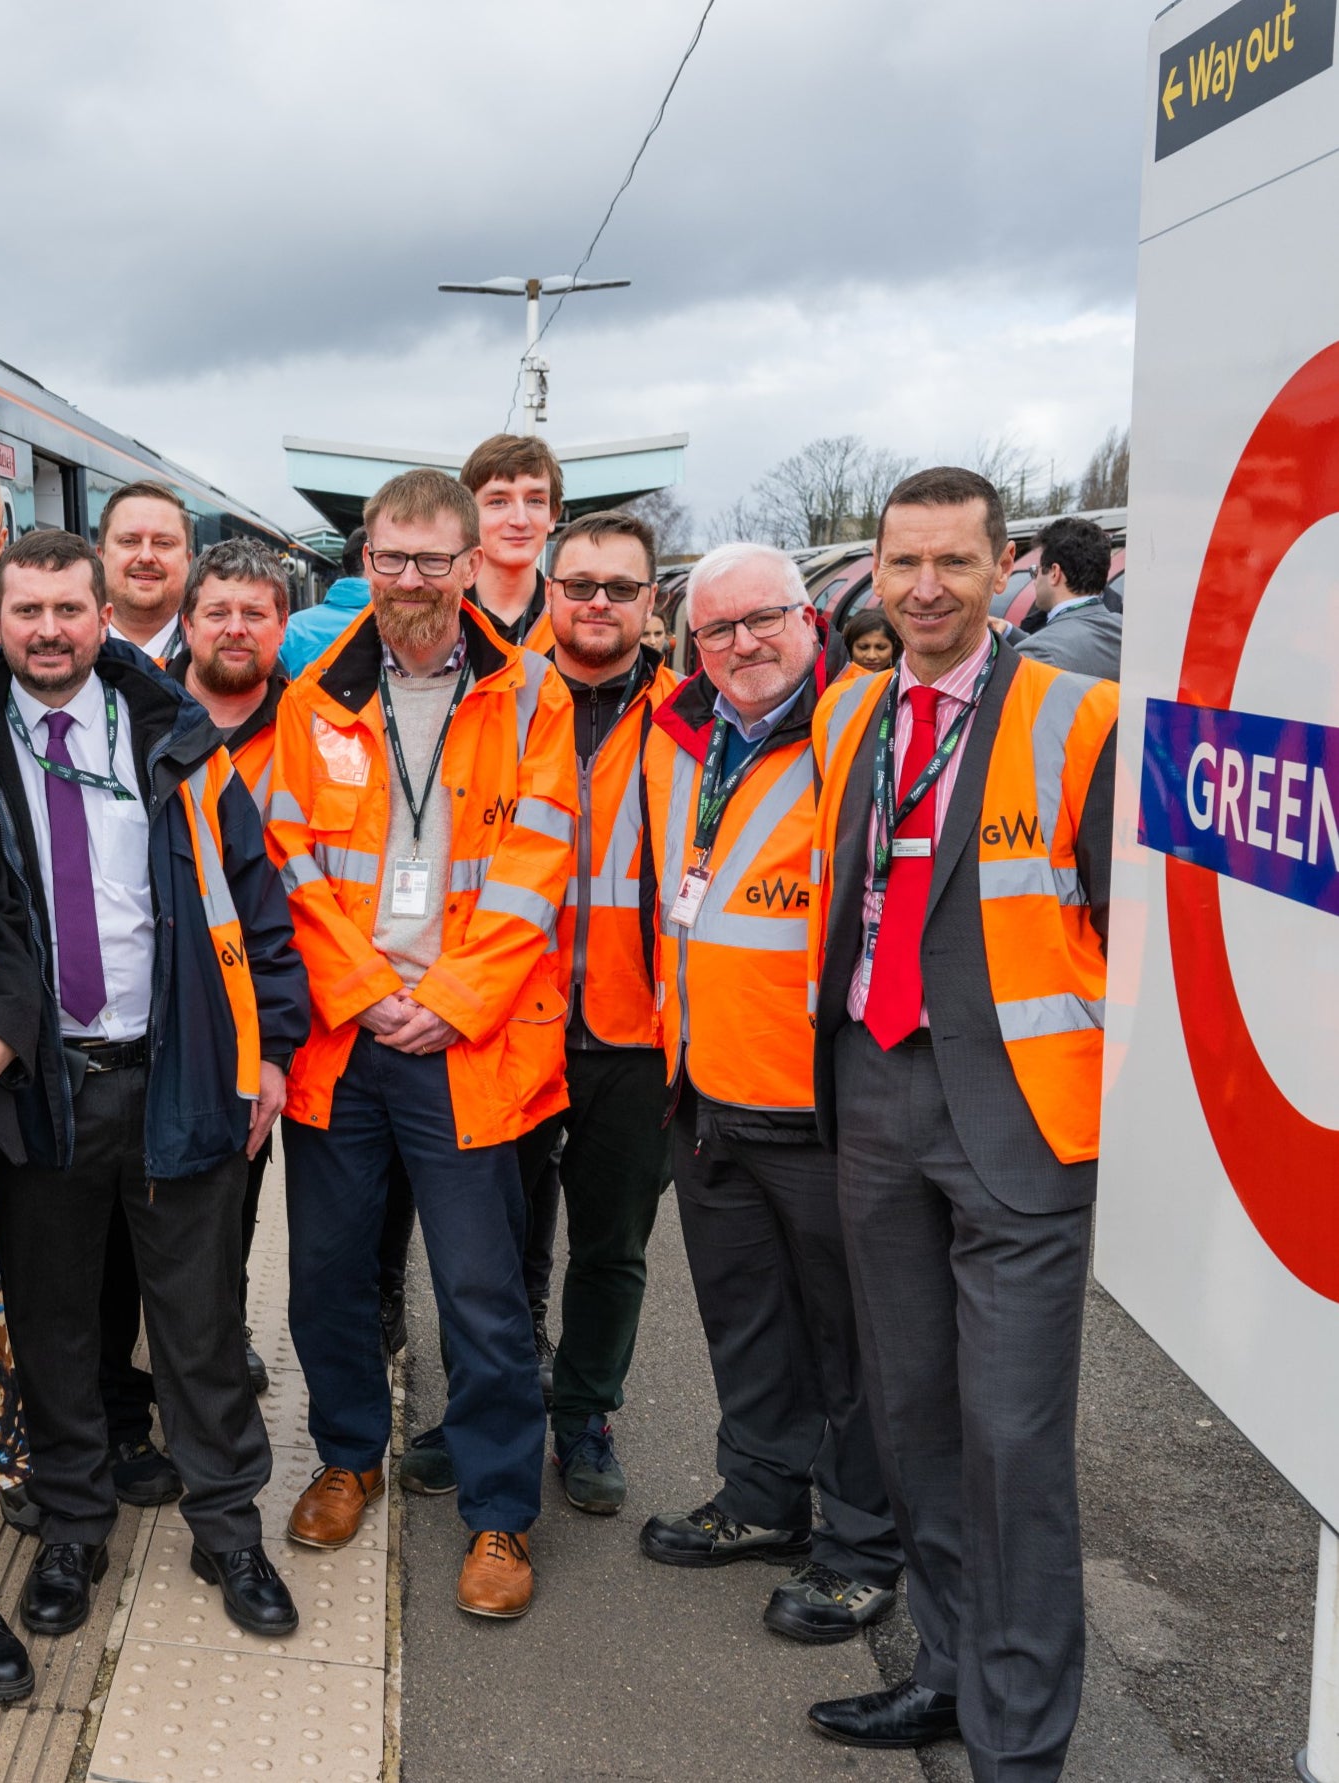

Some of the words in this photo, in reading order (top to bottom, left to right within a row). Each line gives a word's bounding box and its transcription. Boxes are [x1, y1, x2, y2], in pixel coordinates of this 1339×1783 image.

[1189, 41, 1242, 107] Way
[1246, 0, 1296, 73] out
[982, 810, 1045, 850] GW
[1187, 741, 1339, 873] GREEN
[746, 876, 810, 911] GWR
